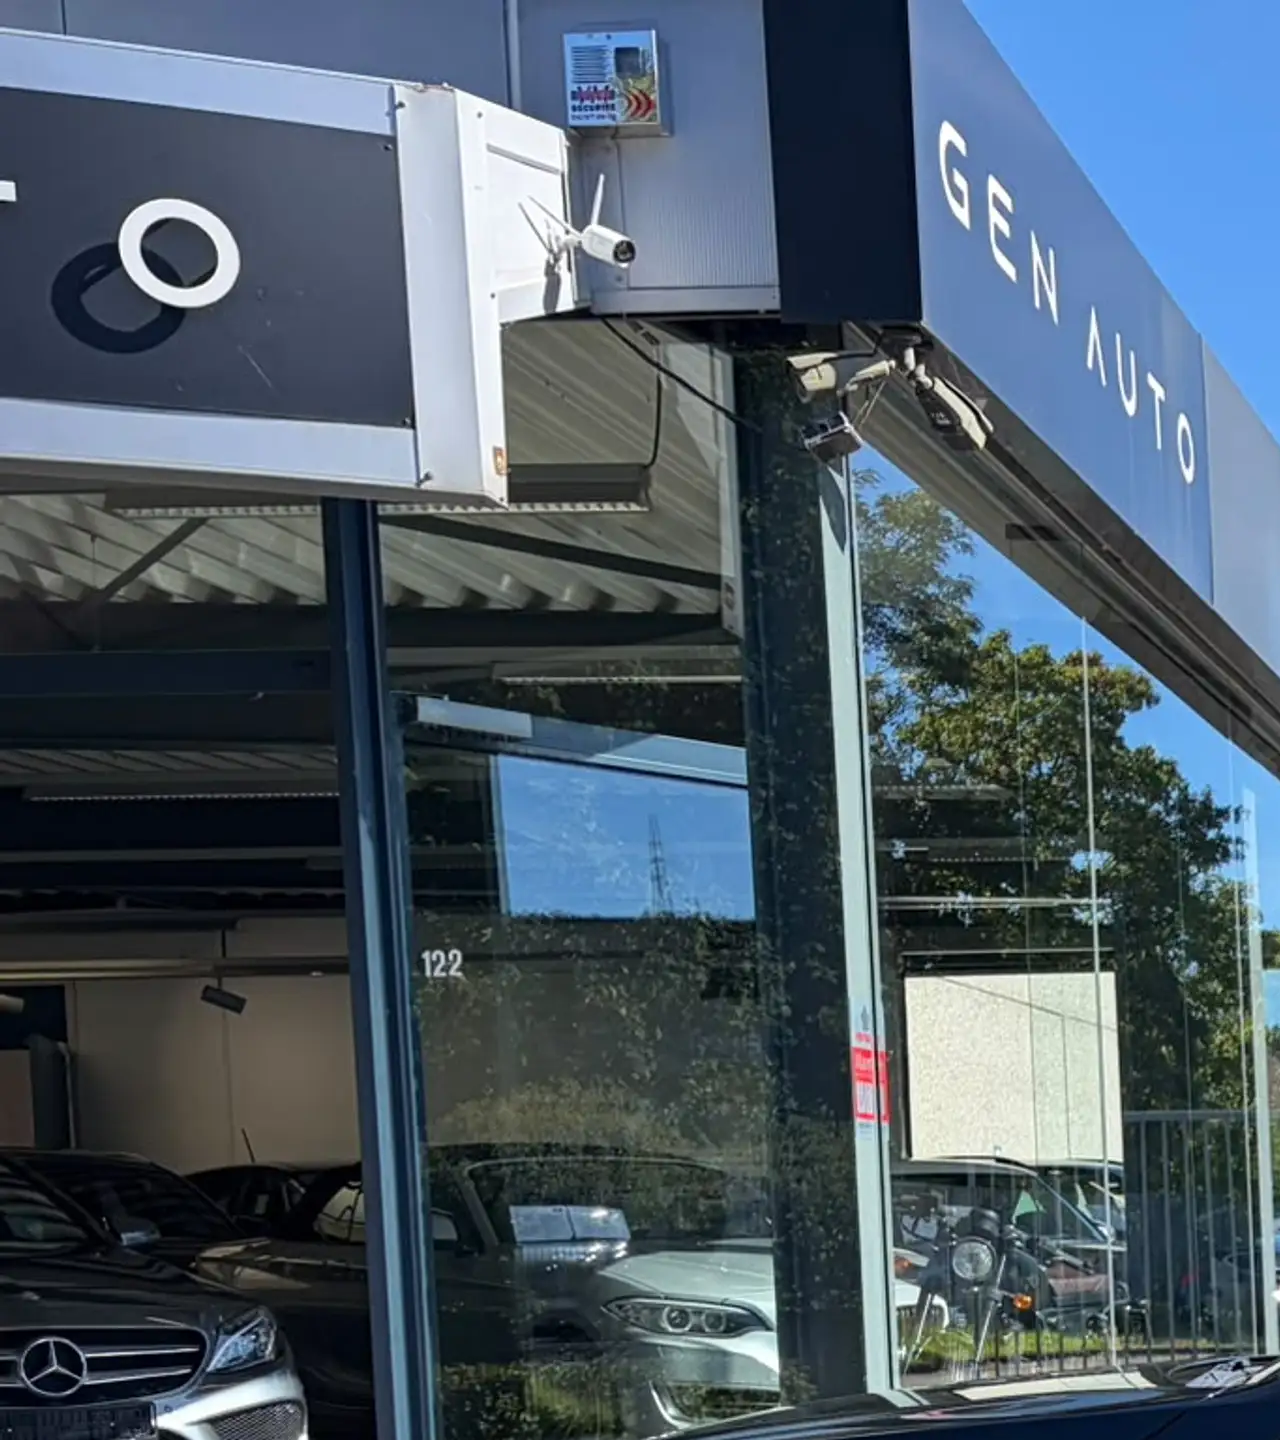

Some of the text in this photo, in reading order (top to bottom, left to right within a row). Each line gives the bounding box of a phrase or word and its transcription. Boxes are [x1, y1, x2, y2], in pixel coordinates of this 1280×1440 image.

[938, 120, 1195, 485] GEN AUTO
[421, 948, 463, 978] 122
